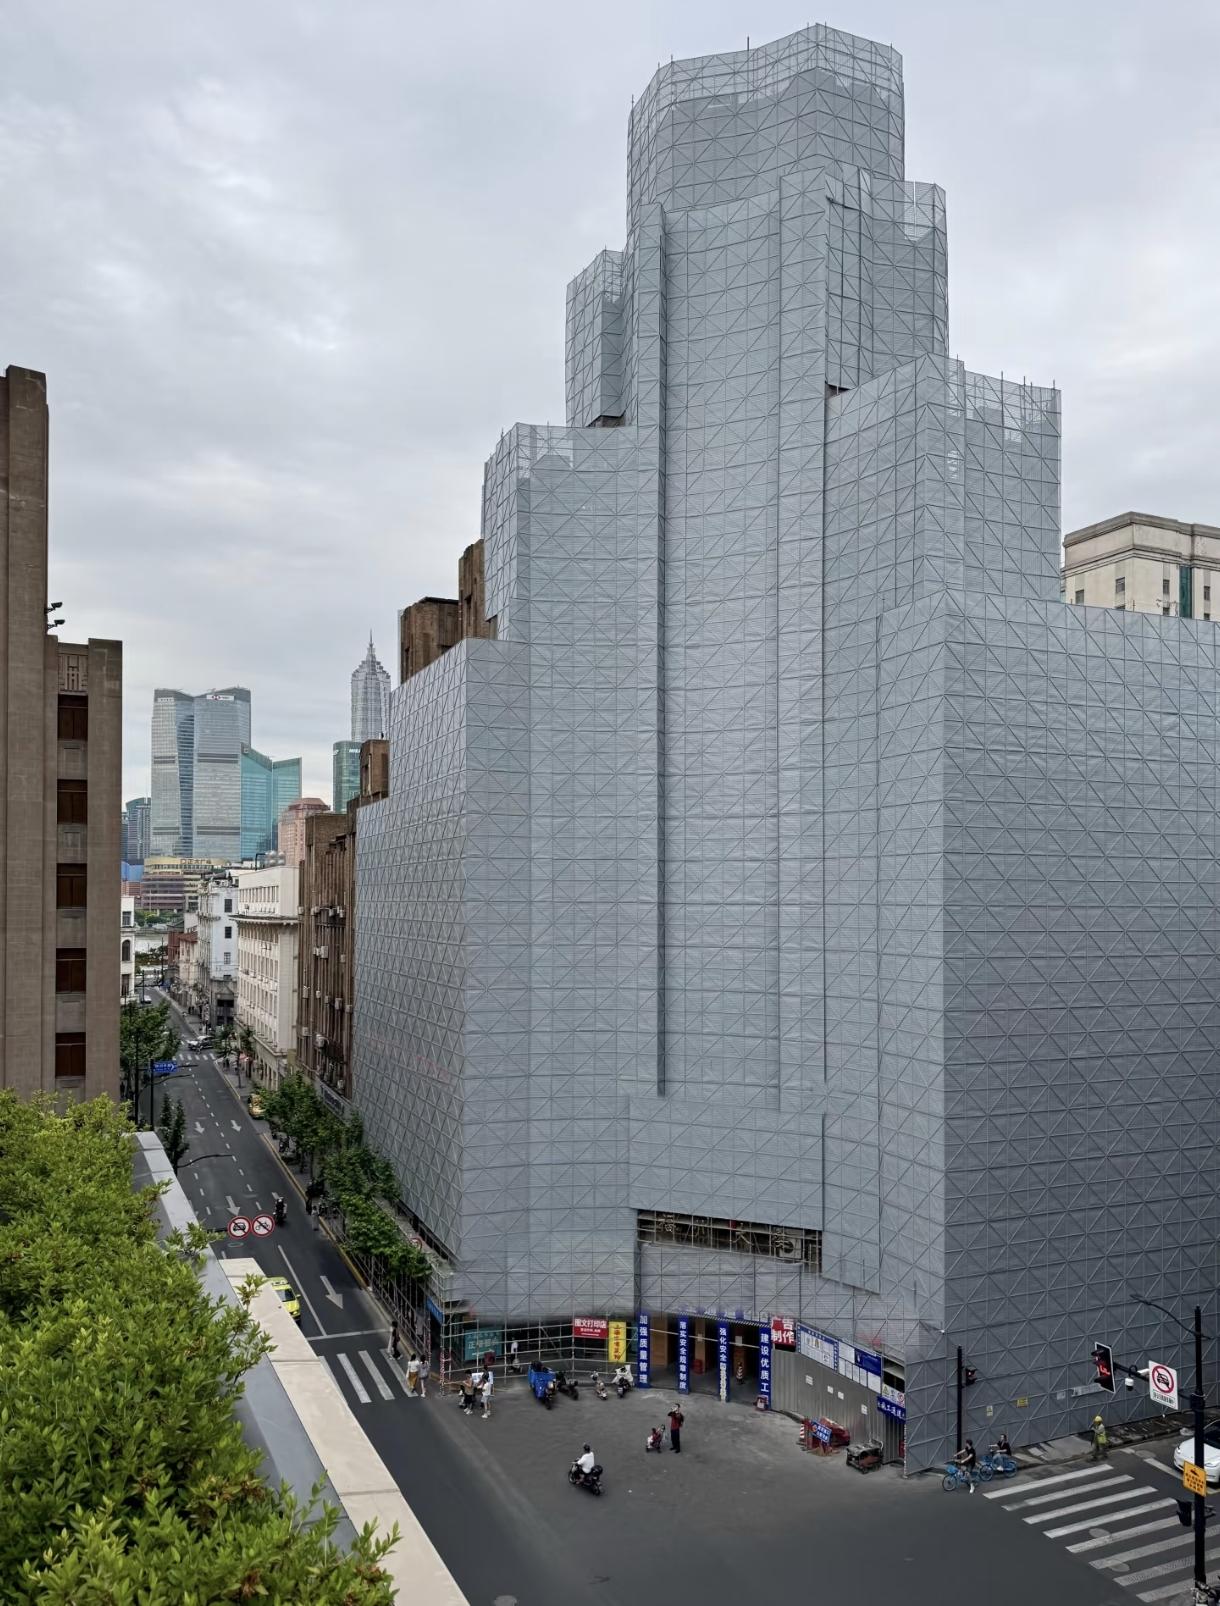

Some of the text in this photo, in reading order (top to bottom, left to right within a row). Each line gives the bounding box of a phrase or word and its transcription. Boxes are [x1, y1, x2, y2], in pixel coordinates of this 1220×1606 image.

[574, 1318, 607, 1329] 图文打印店
[771, 1317, 794, 1330] 广告
[771, 1330, 795, 1344] 制作
[639, 1315, 648, 1384] 加强质量管理
[679, 1321, 687, 1390] 落实安全规章制度
